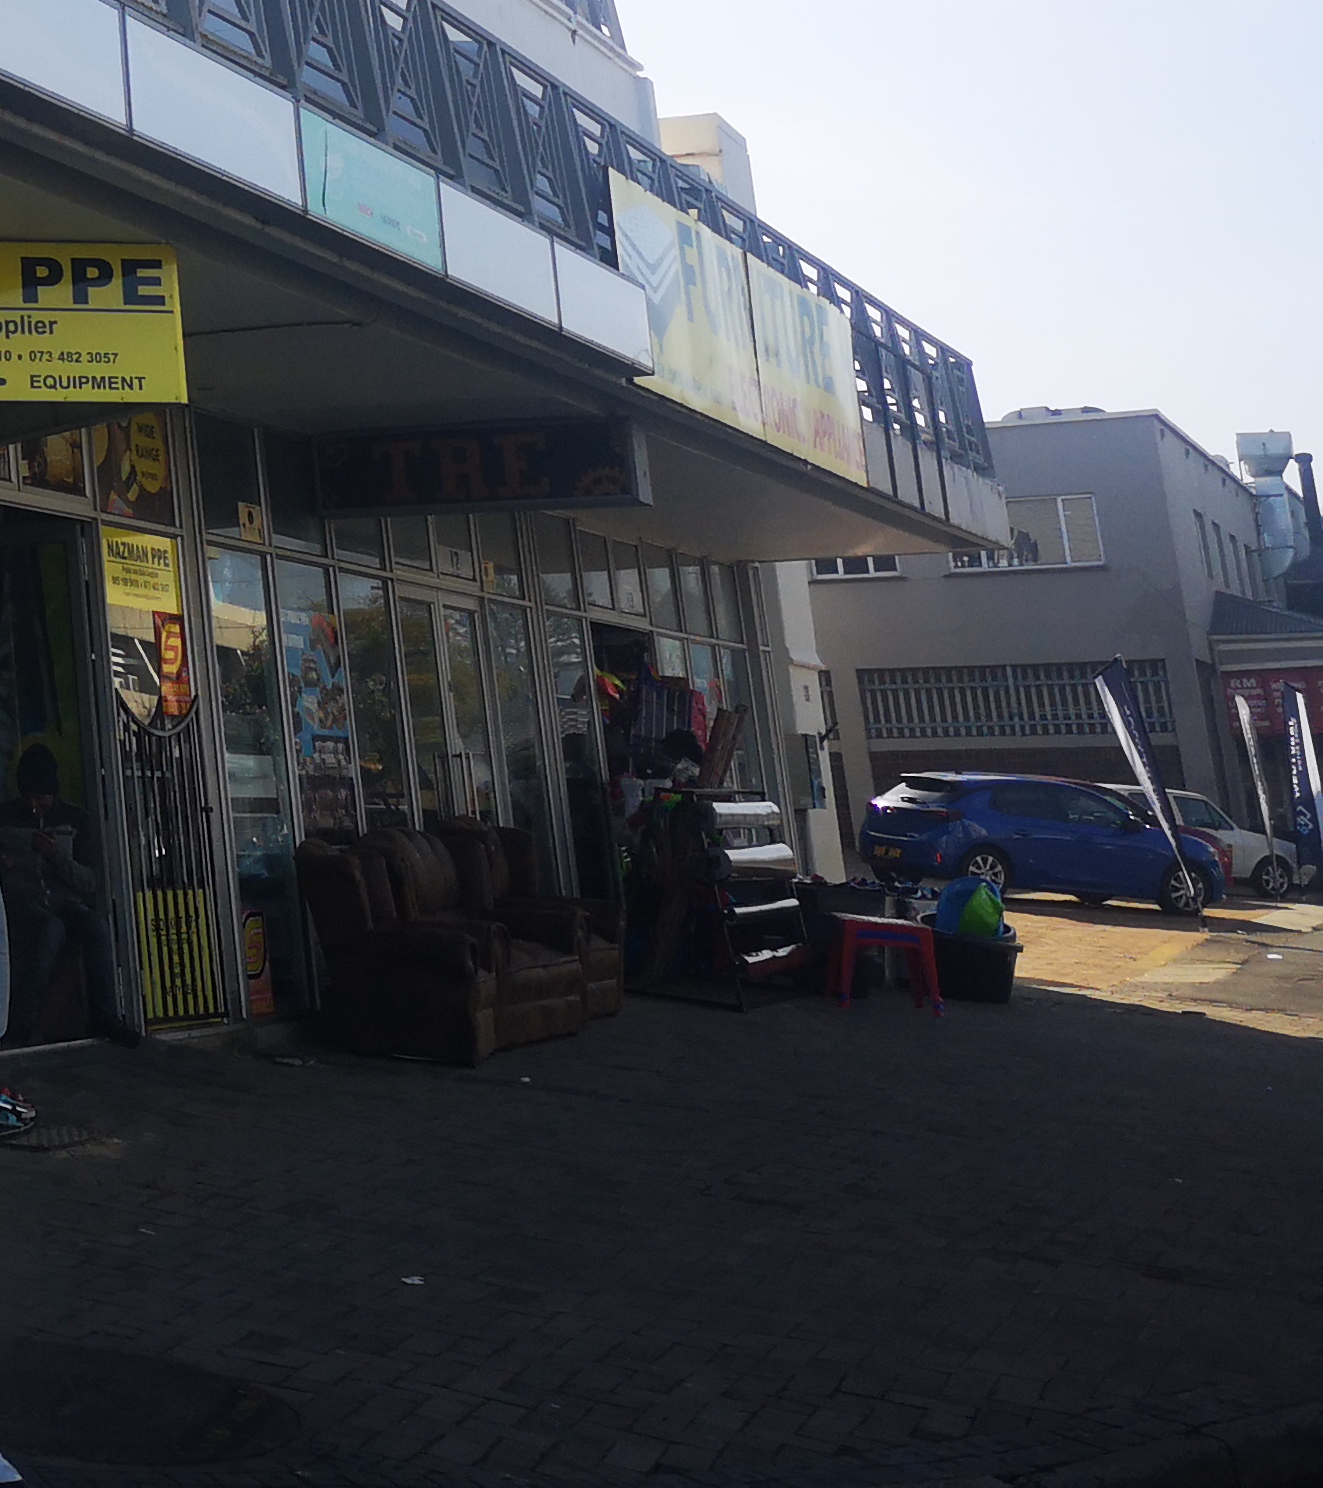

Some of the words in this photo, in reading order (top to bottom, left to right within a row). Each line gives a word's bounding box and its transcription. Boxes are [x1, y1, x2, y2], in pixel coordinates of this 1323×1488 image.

[20, 256, 166, 306] PPE
[28, 351, 53, 362] 073
[57, 351, 82, 363] 482
[87, 352, 118, 364] 3057
[29, 375, 146, 391] EQUIPMENT
[107, 539, 149, 564] NAZMAN
[151, 547, 170, 567] PPE
